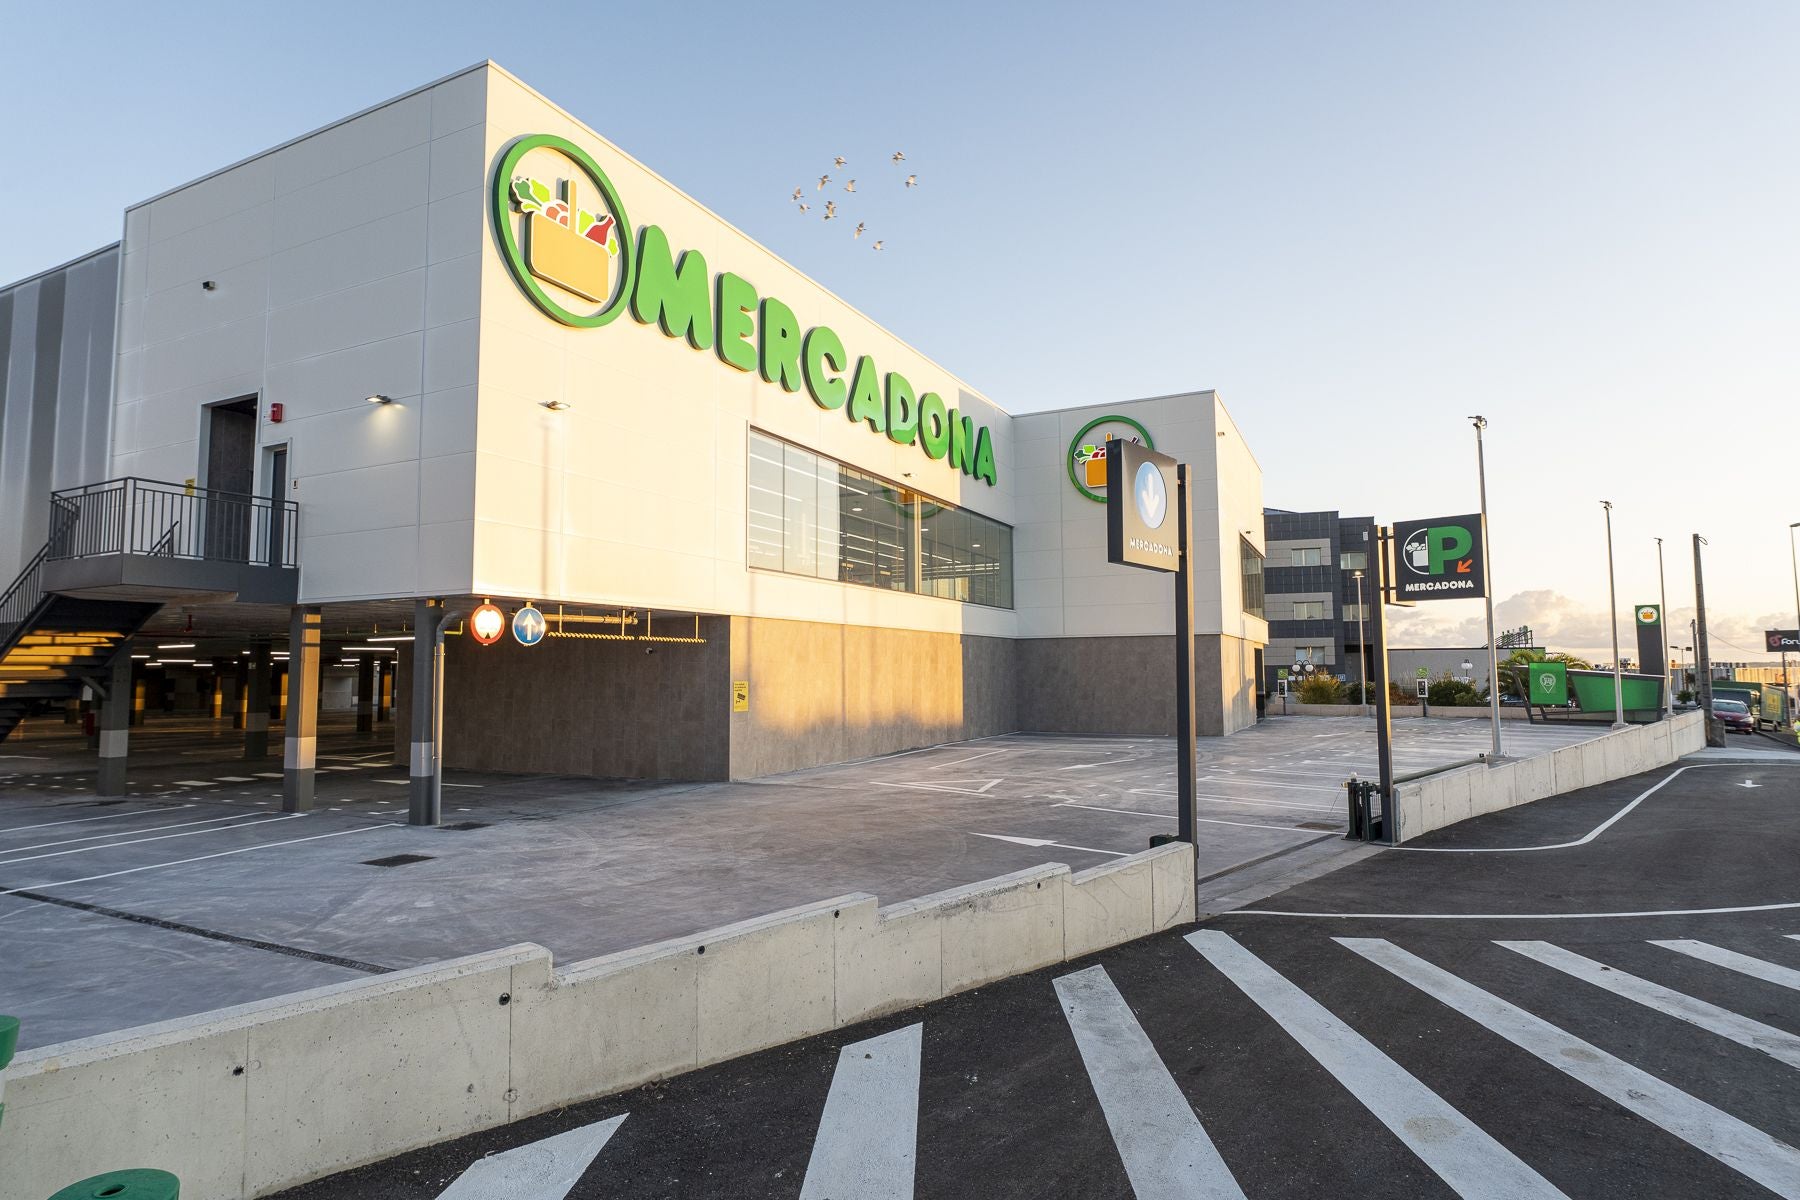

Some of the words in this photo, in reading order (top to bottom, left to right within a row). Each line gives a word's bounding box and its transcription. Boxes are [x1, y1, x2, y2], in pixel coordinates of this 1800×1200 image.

[631, 225, 997, 486] MERCADONA
[1129, 538, 1174, 557] MERCADONA
[1427, 525, 1473, 575] P
[1405, 580, 1474, 592] MERCADONA
